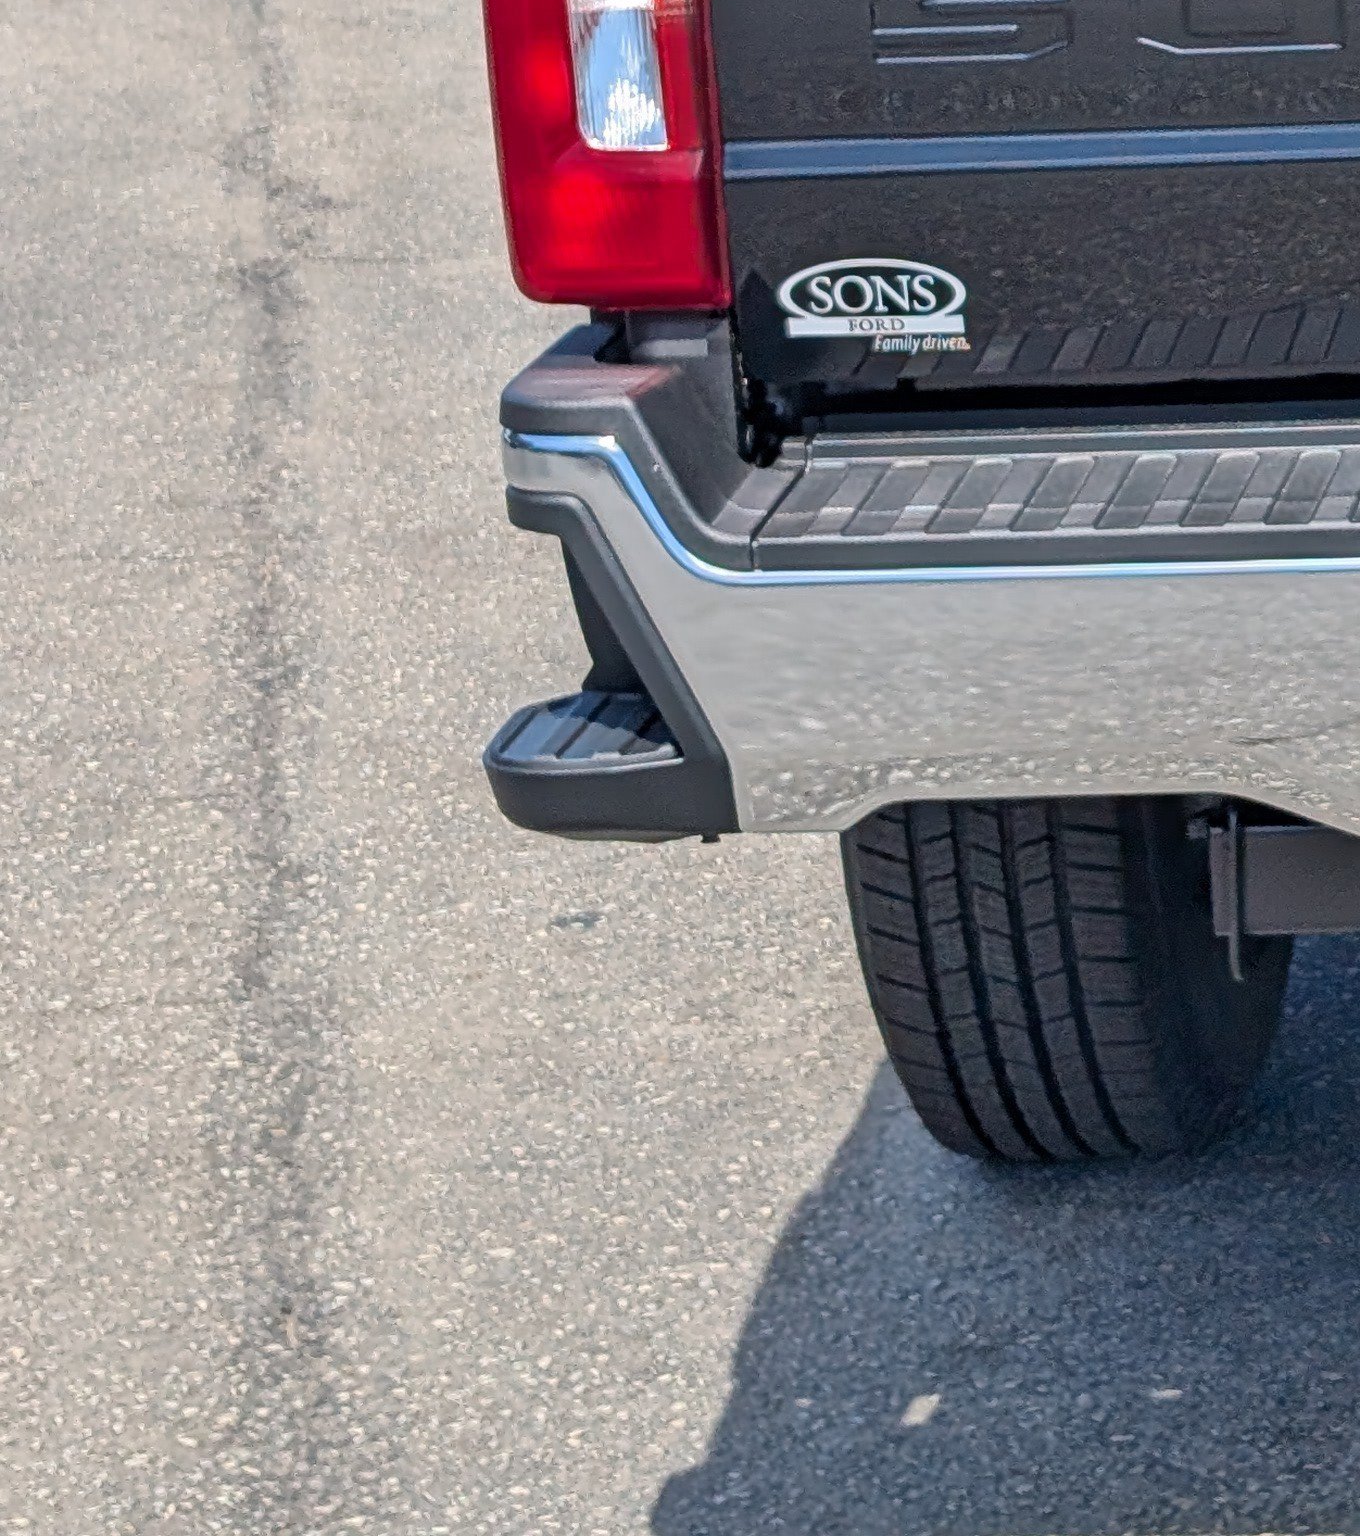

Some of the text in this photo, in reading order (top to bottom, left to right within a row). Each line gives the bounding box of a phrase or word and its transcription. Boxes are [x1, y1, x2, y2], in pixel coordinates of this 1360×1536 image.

[808, 275, 937, 314] SONS
[849, 318, 906, 332] FORD
[874, 334, 921, 355] Family
